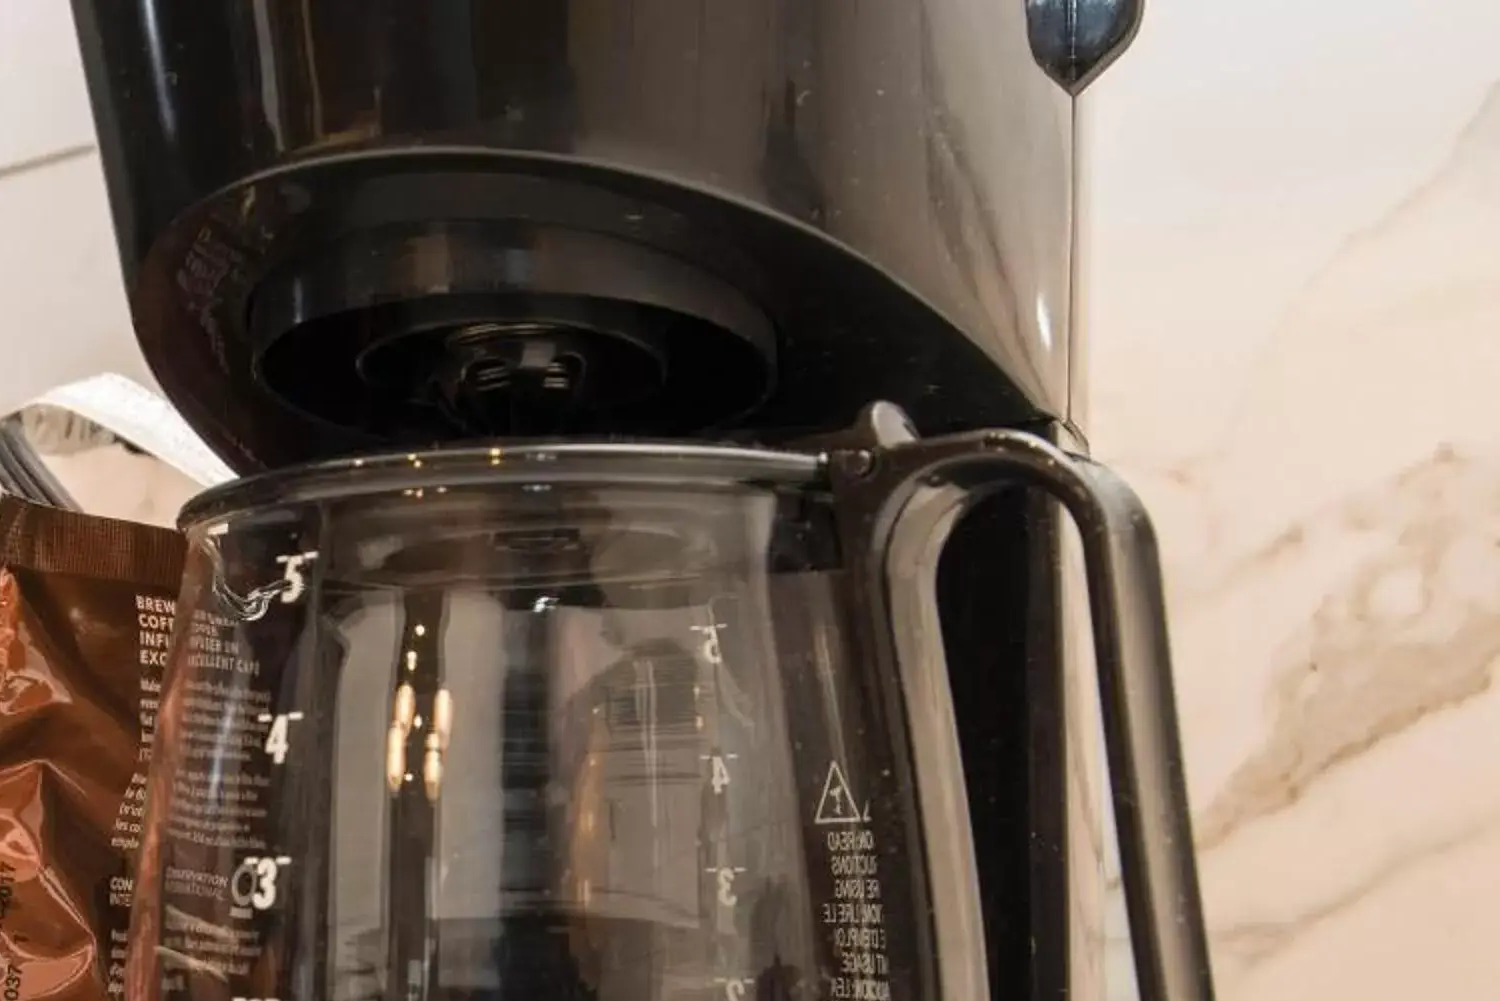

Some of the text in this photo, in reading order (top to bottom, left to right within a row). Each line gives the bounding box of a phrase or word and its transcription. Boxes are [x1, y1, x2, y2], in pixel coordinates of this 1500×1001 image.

[281, 555, 303, 603] 5
[265, 715, 288, 763] 4
[253, 857, 277, 910] 3
